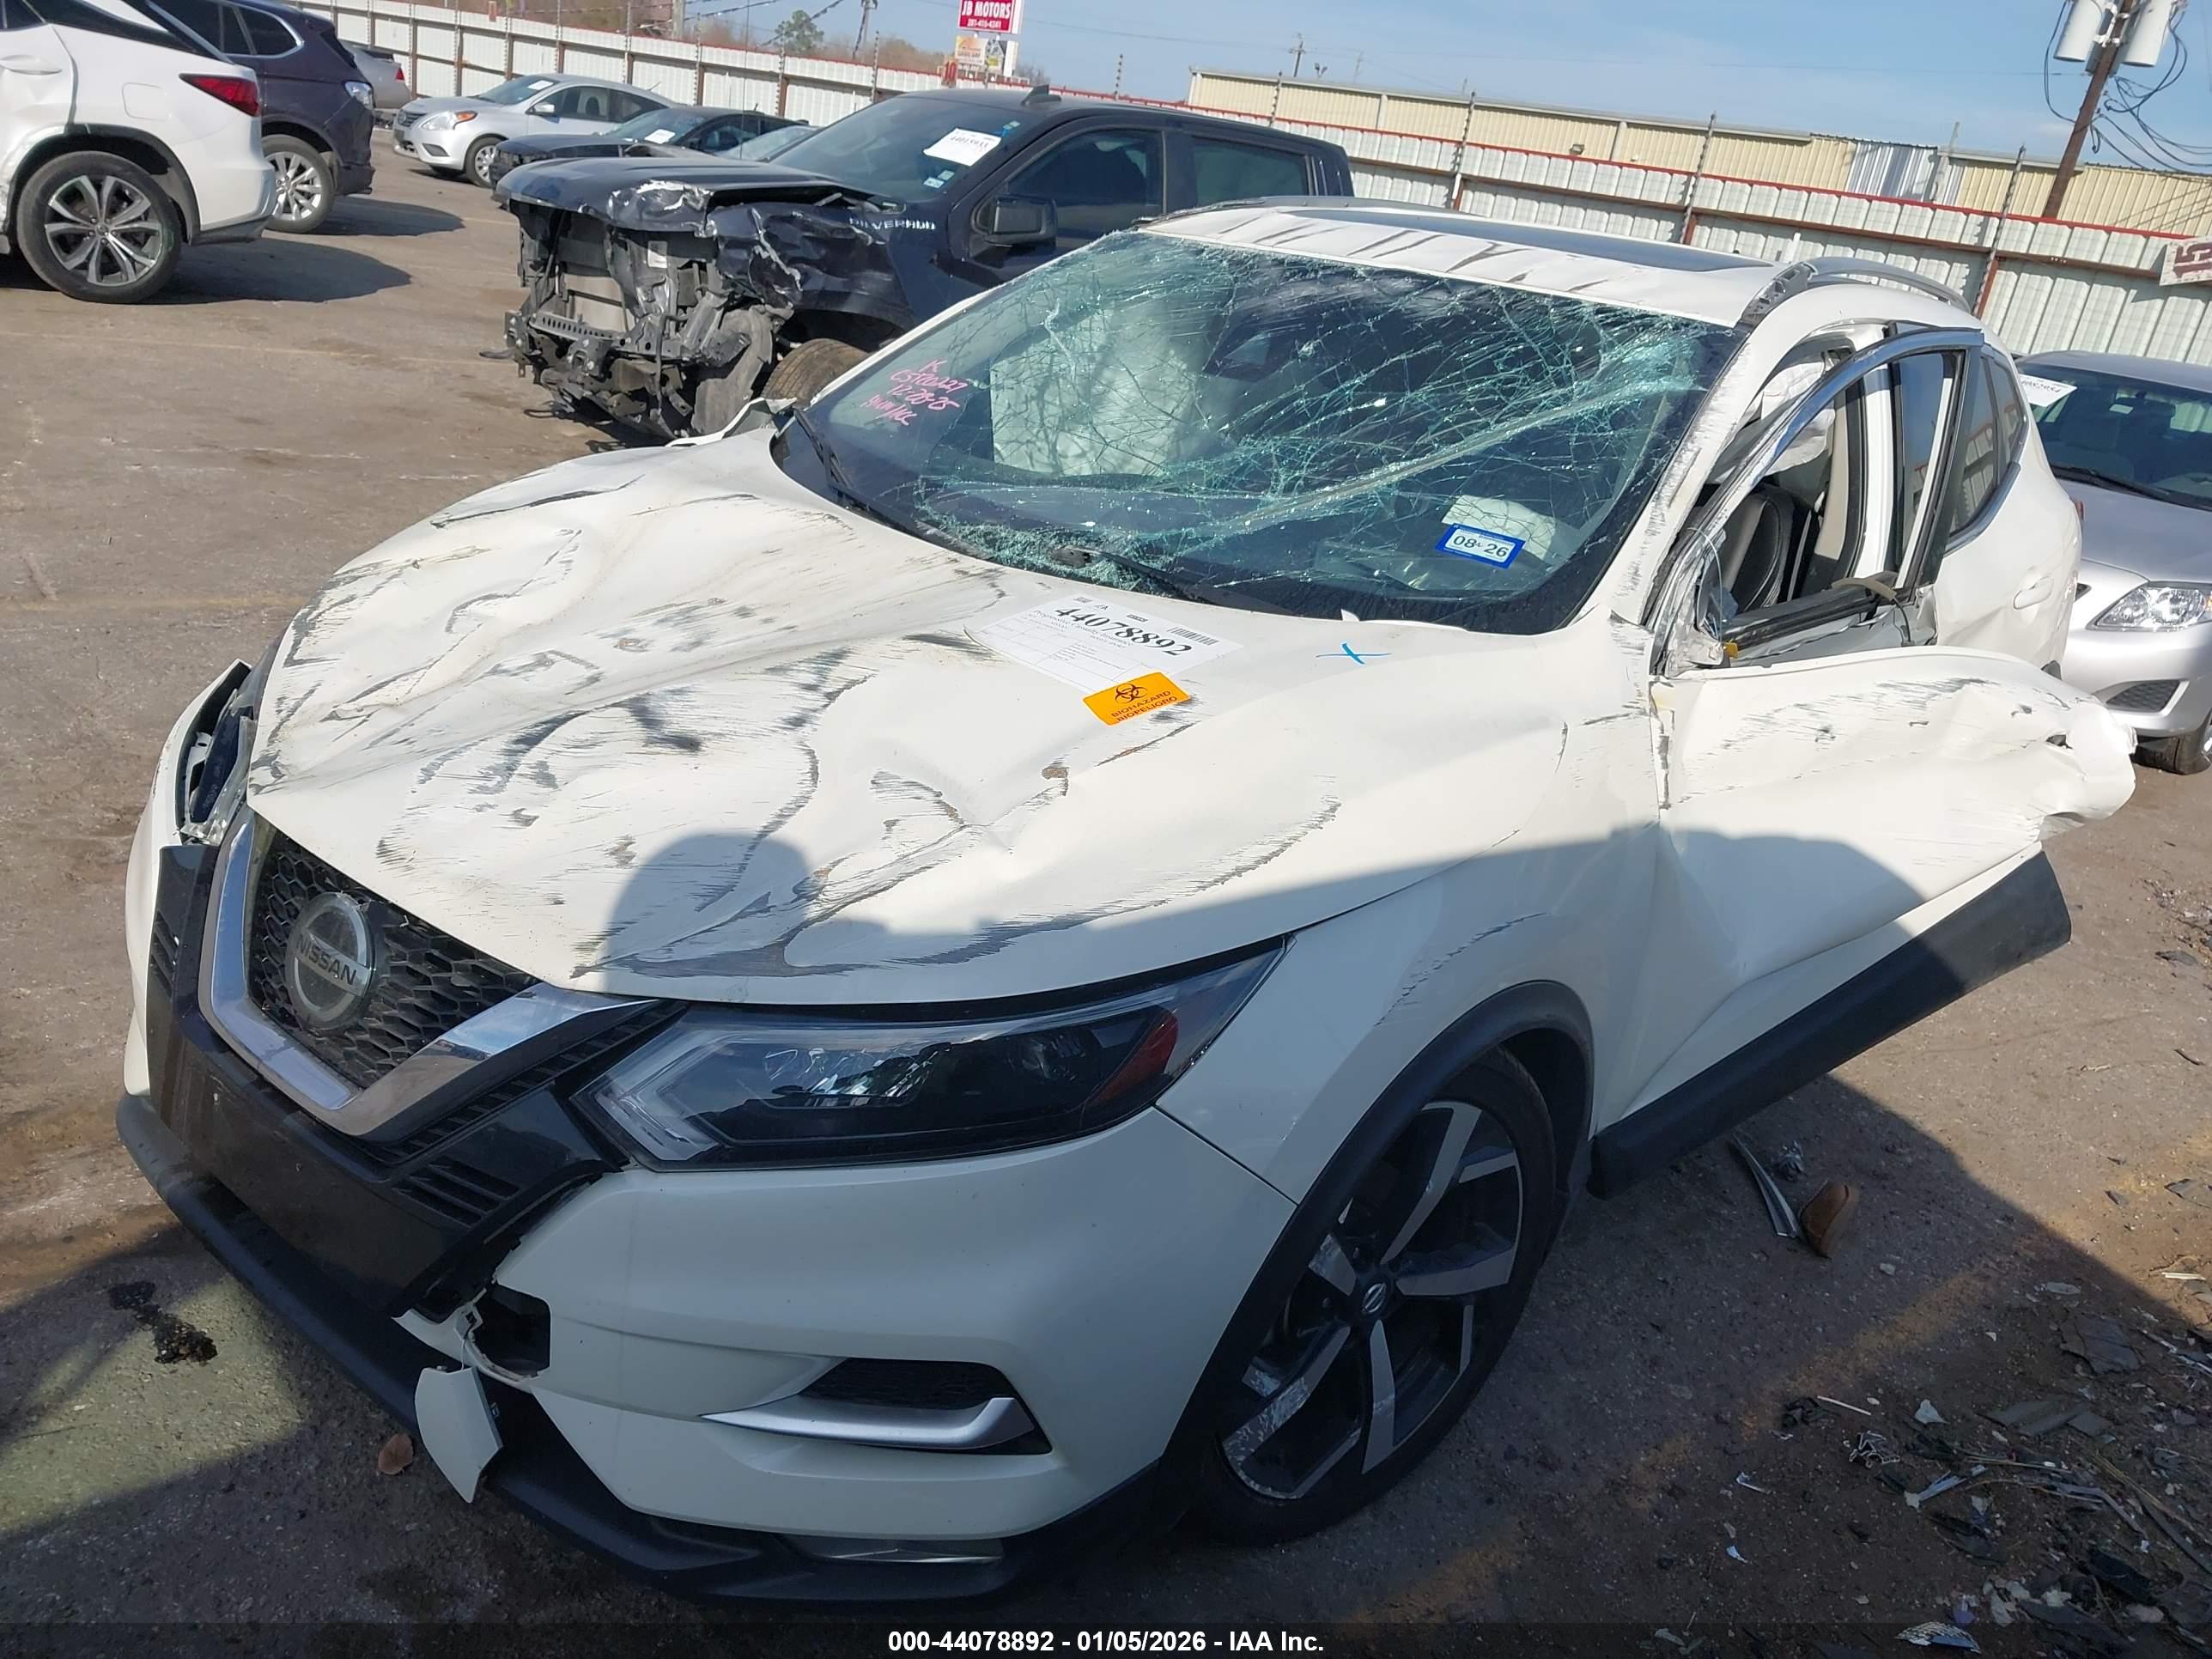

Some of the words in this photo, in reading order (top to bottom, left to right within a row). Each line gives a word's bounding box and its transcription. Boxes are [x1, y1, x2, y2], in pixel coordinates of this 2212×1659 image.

[962, 1, 973, 16] JB
[974, 2, 1011, 19] MOTORS
[1453, 535, 1476, 549] 08
[1484, 544, 1509, 557] 26
[1054, 608, 1193, 656] 44078892
[1111, 690, 1171, 717] BIOHAZARD
[1117, 696, 1178, 722] BIOPELIGRO
[297, 937, 357, 985] NISSAN
